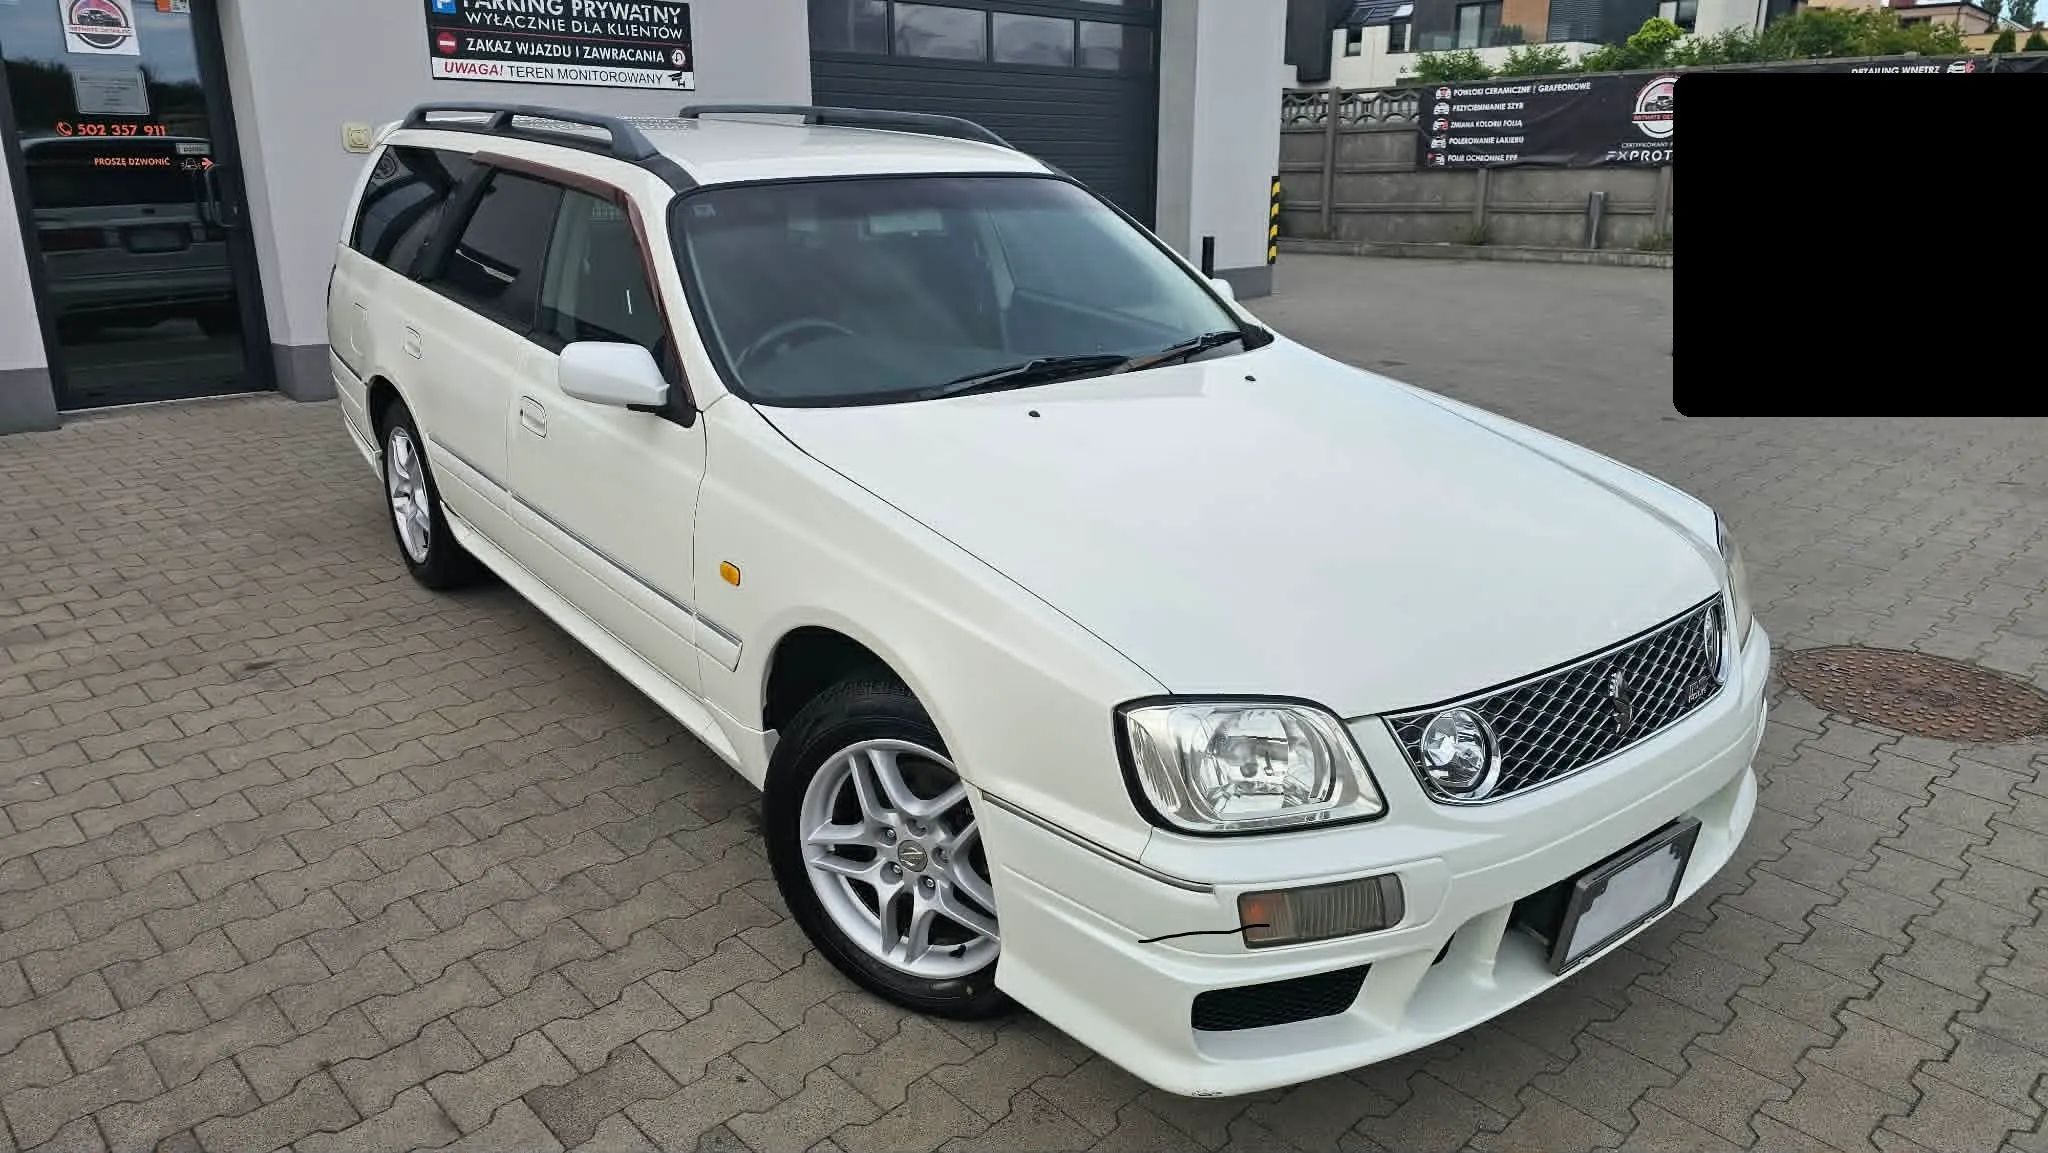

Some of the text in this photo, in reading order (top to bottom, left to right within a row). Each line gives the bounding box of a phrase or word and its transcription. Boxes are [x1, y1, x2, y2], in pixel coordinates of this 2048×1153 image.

[571, 0, 681, 24] PRYWATNY
[465, 11, 683, 39] WYŁĄCZNIE DLA KLIENTÓW
[465, 38, 665, 63] ZAKAZ WJAZDU I ZAWRACANIA
[444, 61, 664, 84] UWAGA! TEREN MONITOROWANY
[77, 124, 167, 137] 502 357 911
[94, 156, 171, 168] PROSZĘ DZWONIĆ
